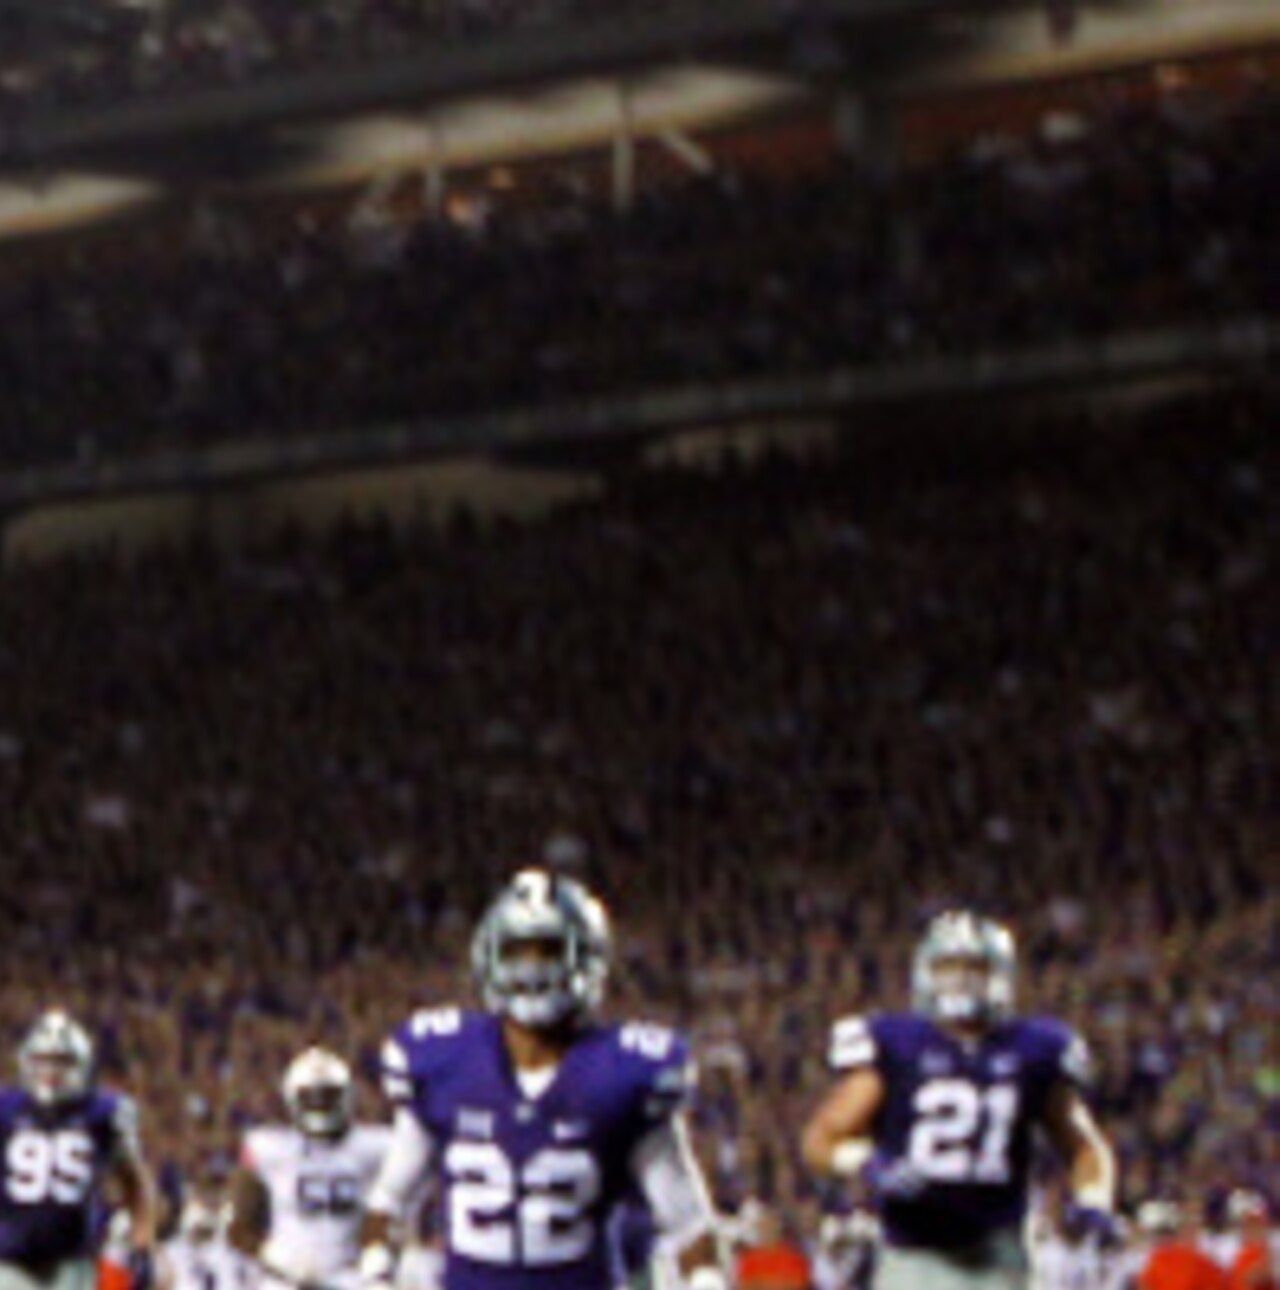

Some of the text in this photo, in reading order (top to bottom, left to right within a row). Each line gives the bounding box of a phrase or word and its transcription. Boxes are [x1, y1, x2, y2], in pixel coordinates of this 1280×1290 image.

[5, 1131, 95, 1204] 95
[908, 1079, 1017, 1184] 21
[445, 1142, 599, 1266] 22
